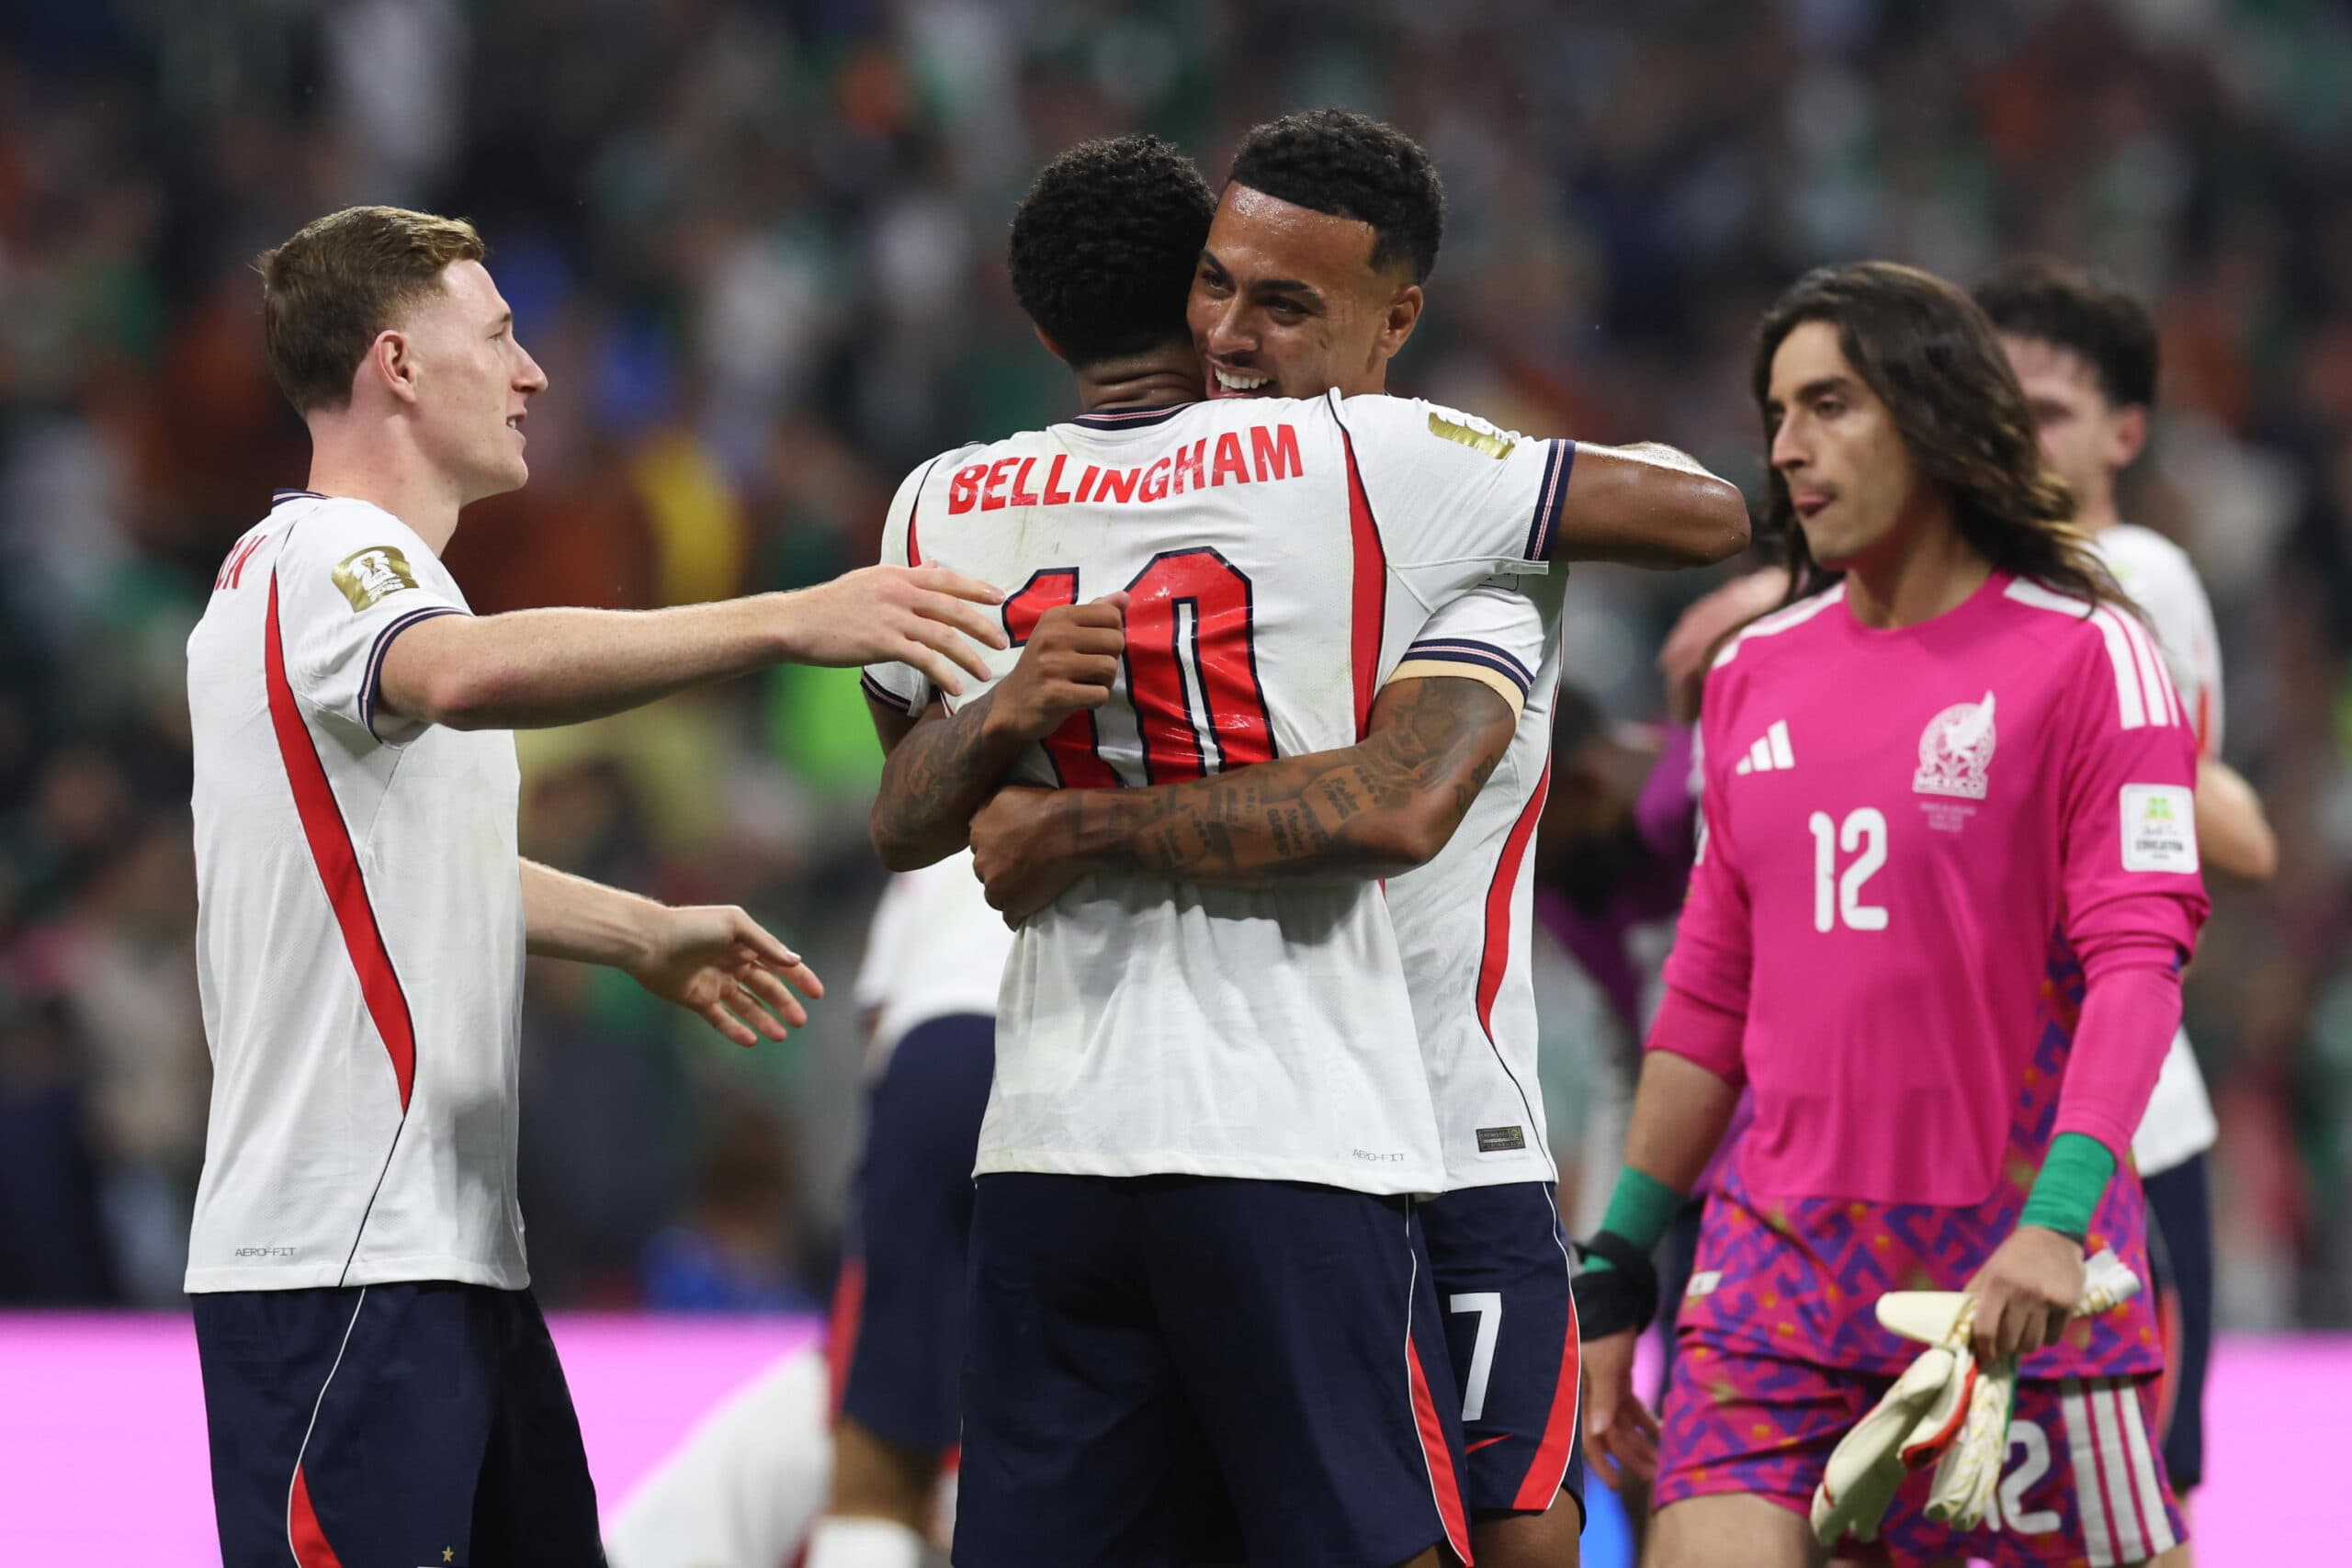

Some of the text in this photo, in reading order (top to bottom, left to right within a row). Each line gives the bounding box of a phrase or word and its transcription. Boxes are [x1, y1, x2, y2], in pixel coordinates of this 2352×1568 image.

[948, 424, 1304, 515] BELLINGHAM
[1001, 546, 1279, 788] 10
[1809, 807, 1888, 932] 12
[235, 1247, 297, 1257] AERO-FIT
[1450, 1292, 1503, 1421] 7
